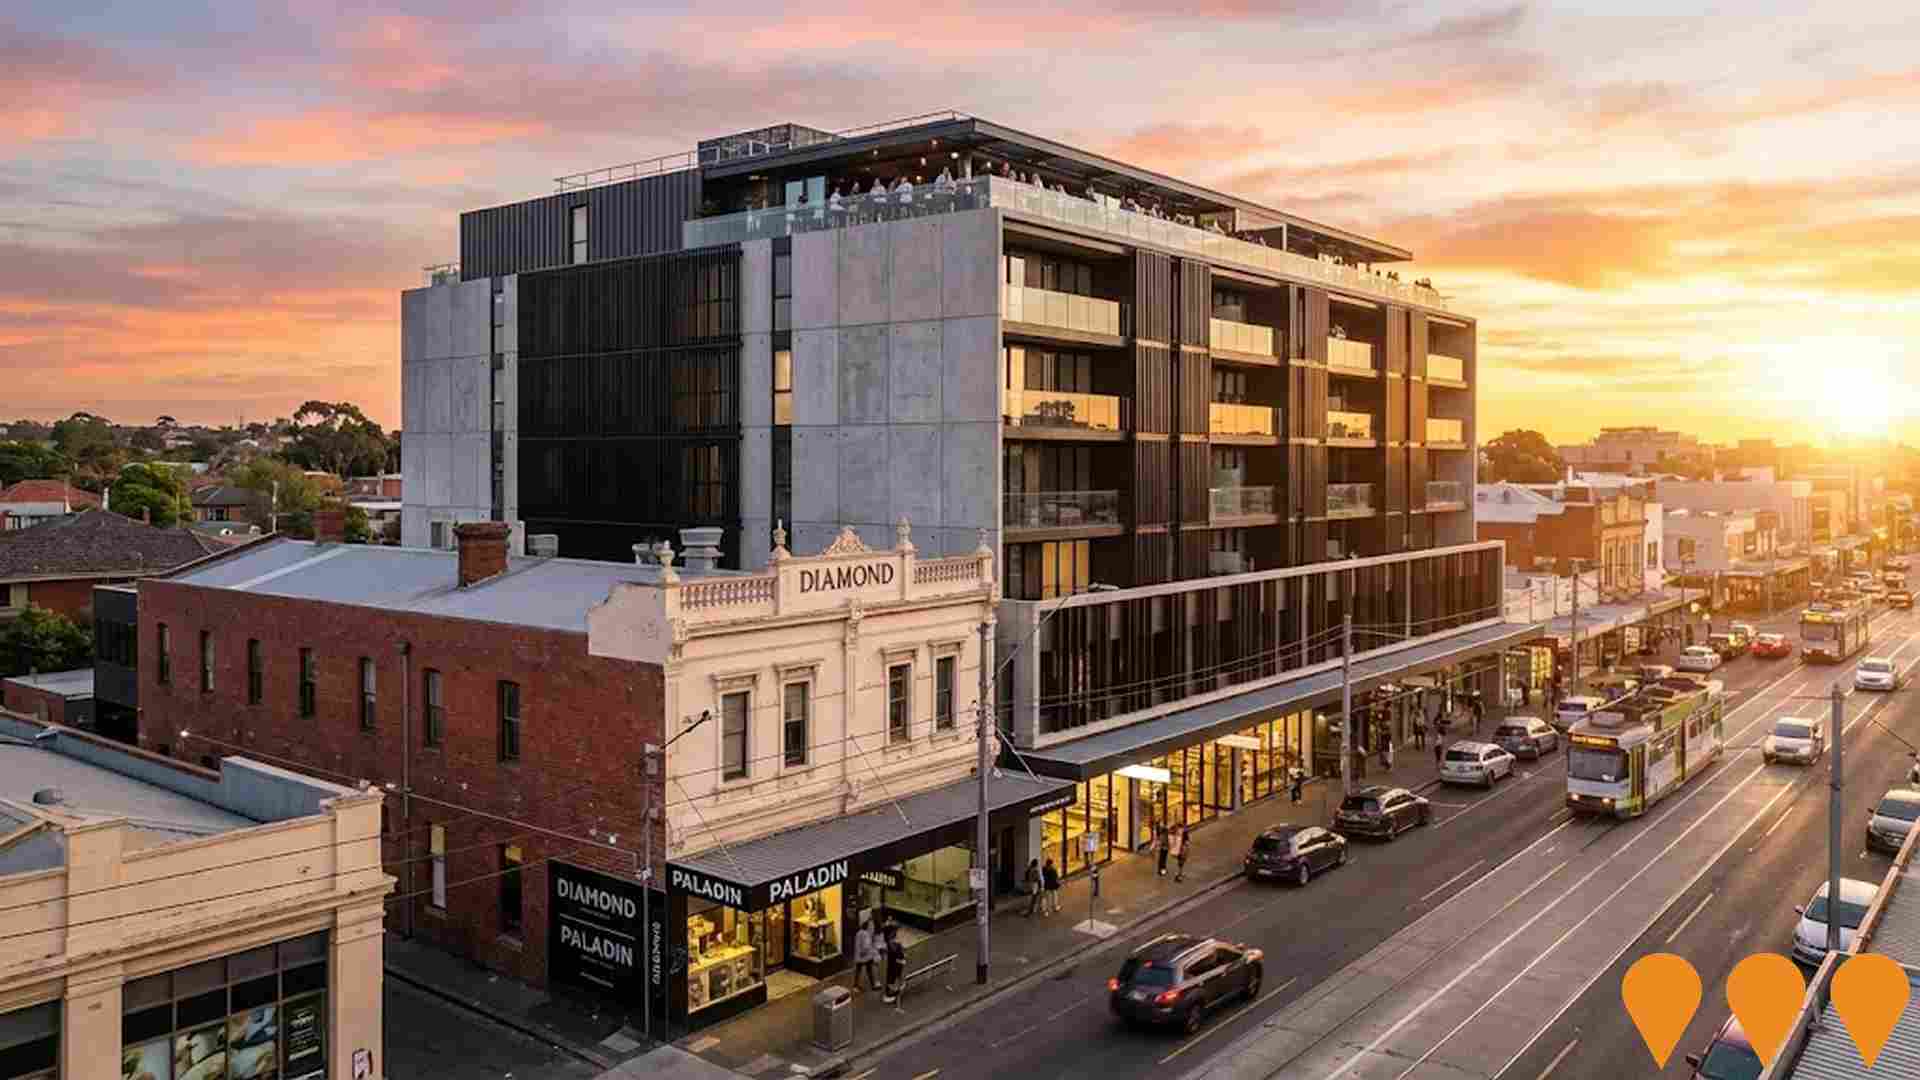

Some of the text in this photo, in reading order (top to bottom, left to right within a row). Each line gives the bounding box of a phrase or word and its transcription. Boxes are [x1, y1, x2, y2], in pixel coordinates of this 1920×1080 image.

[799, 563, 894, 592] DIAMOND
[557, 877, 637, 918] DIAMOND
[769, 860, 849, 903] PALADIN
[561, 925, 633, 968] PALADIN
